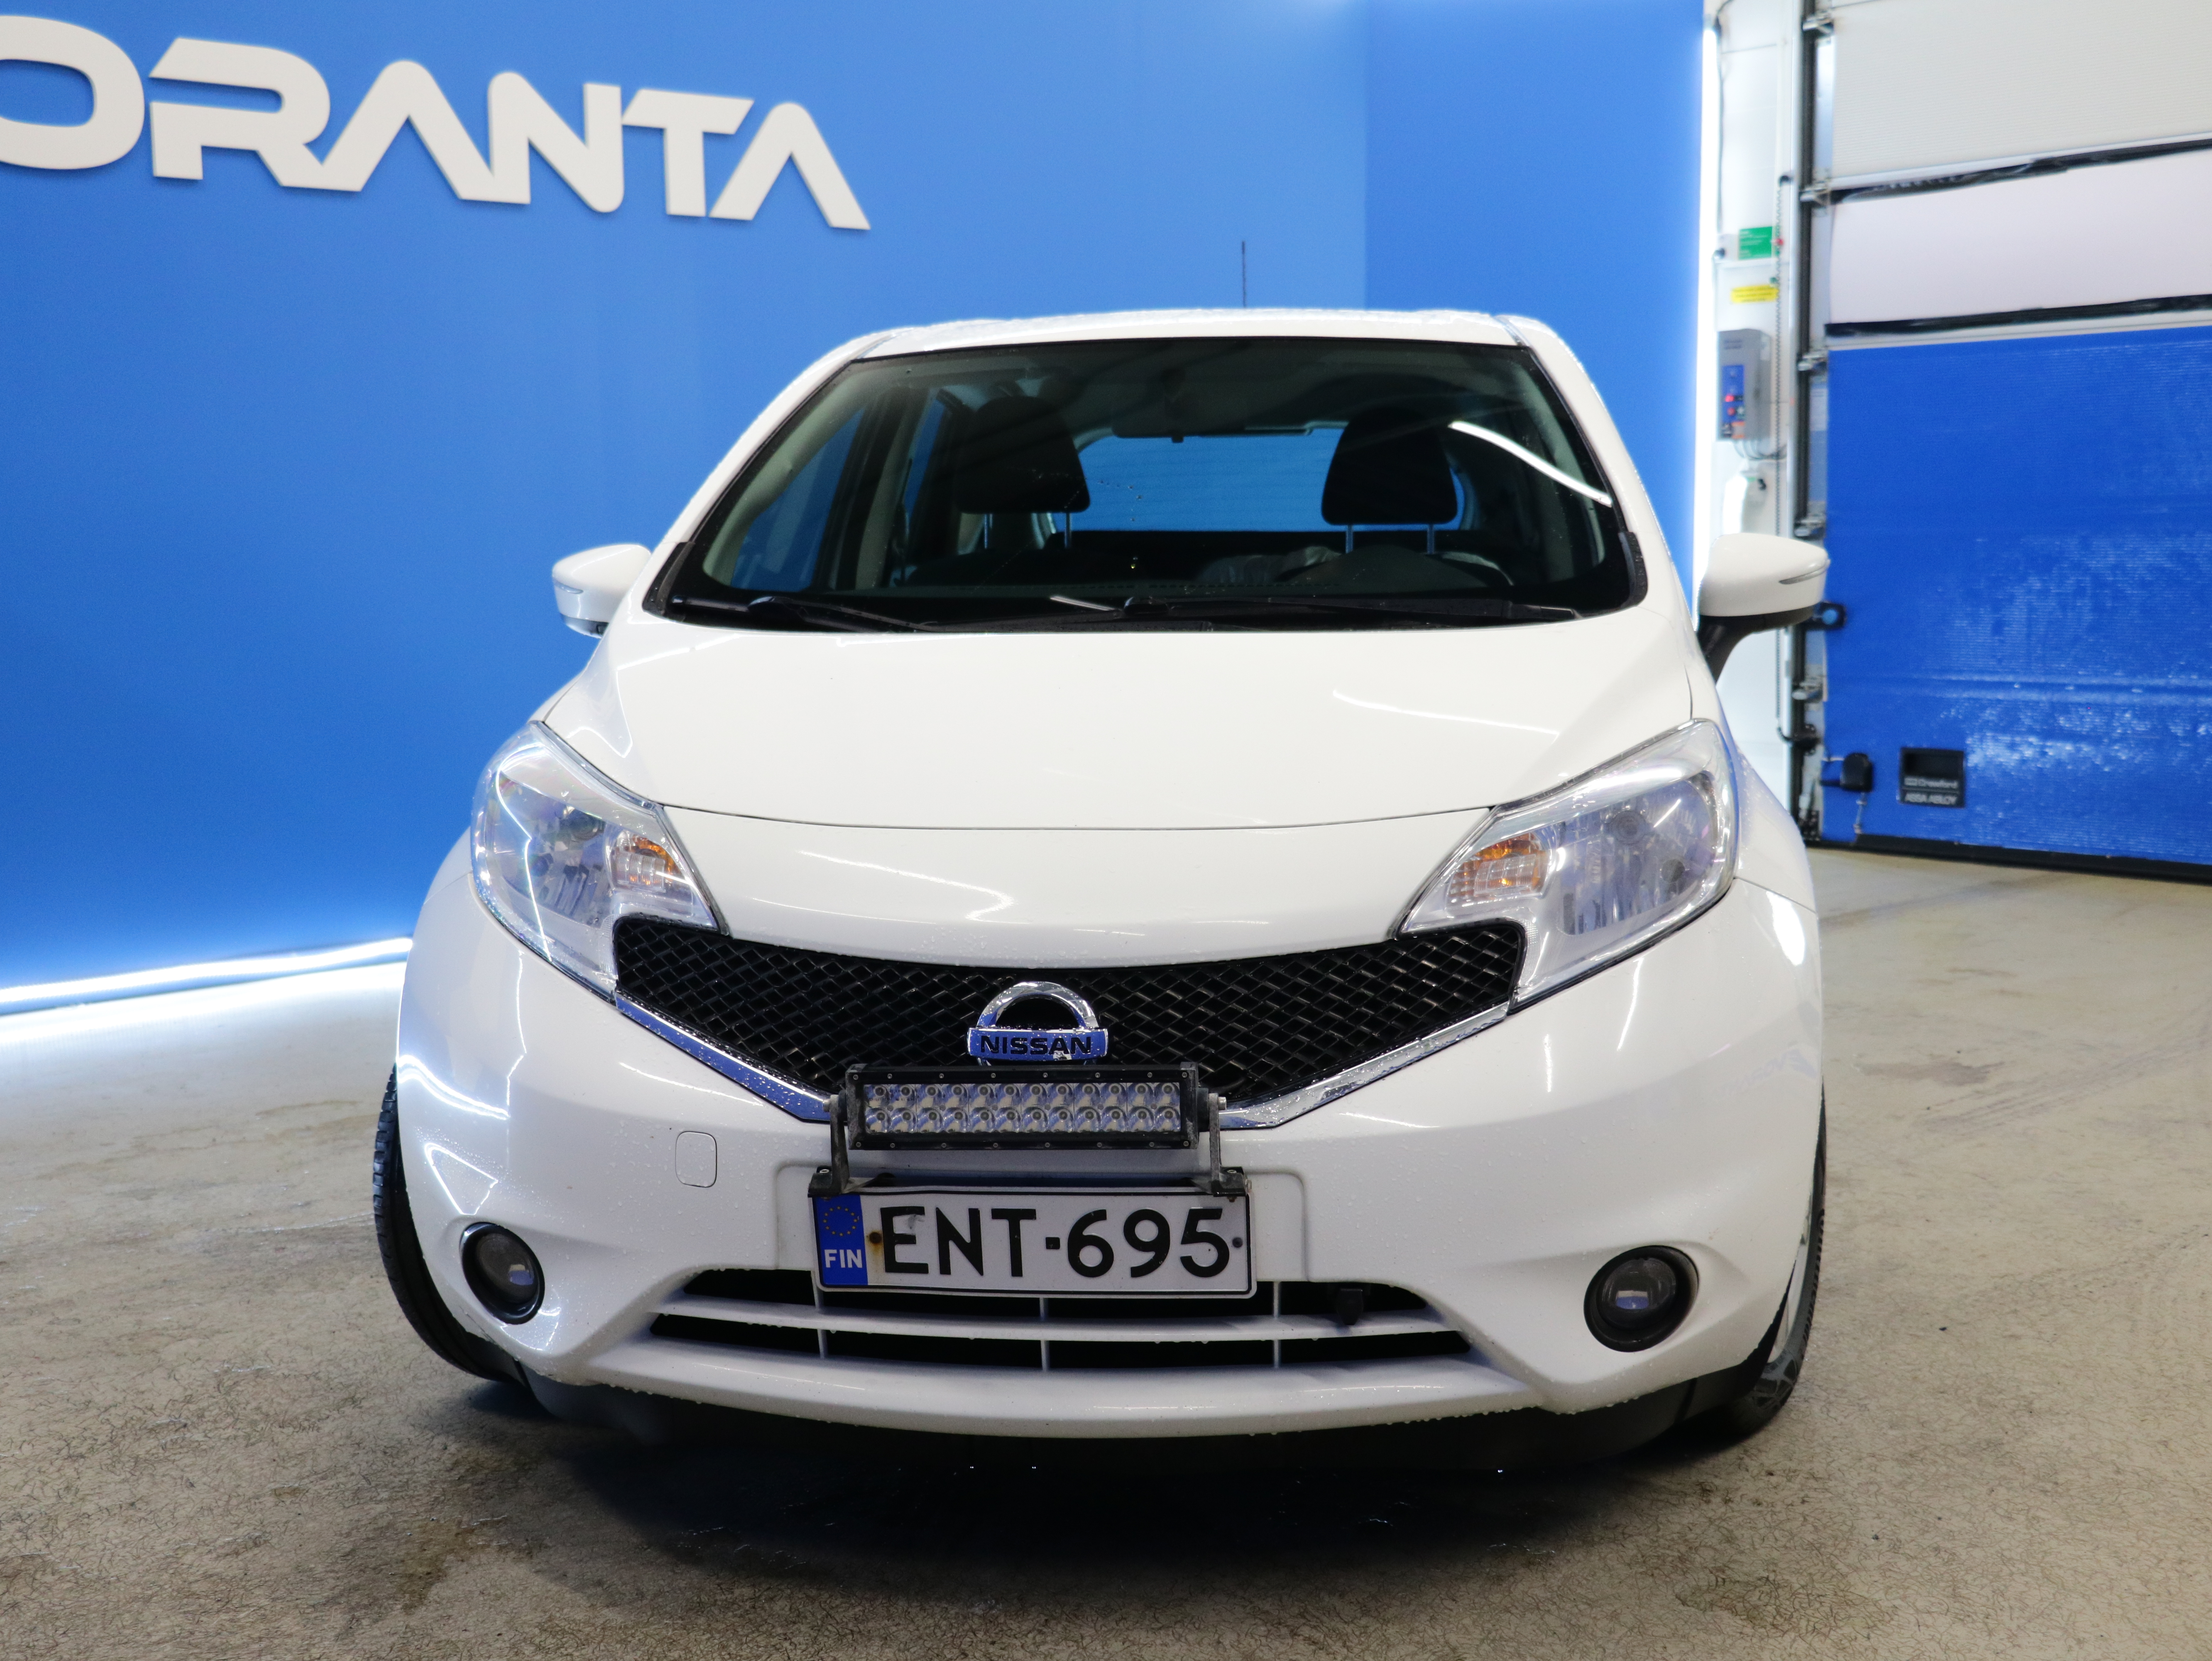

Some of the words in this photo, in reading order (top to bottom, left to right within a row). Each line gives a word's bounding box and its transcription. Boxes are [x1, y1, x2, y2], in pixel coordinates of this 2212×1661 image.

[980, 1035, 1091, 1055] NISSAN
[880, 1205, 1230, 1278] ENT-695
[824, 1249, 863, 1268] FIN
